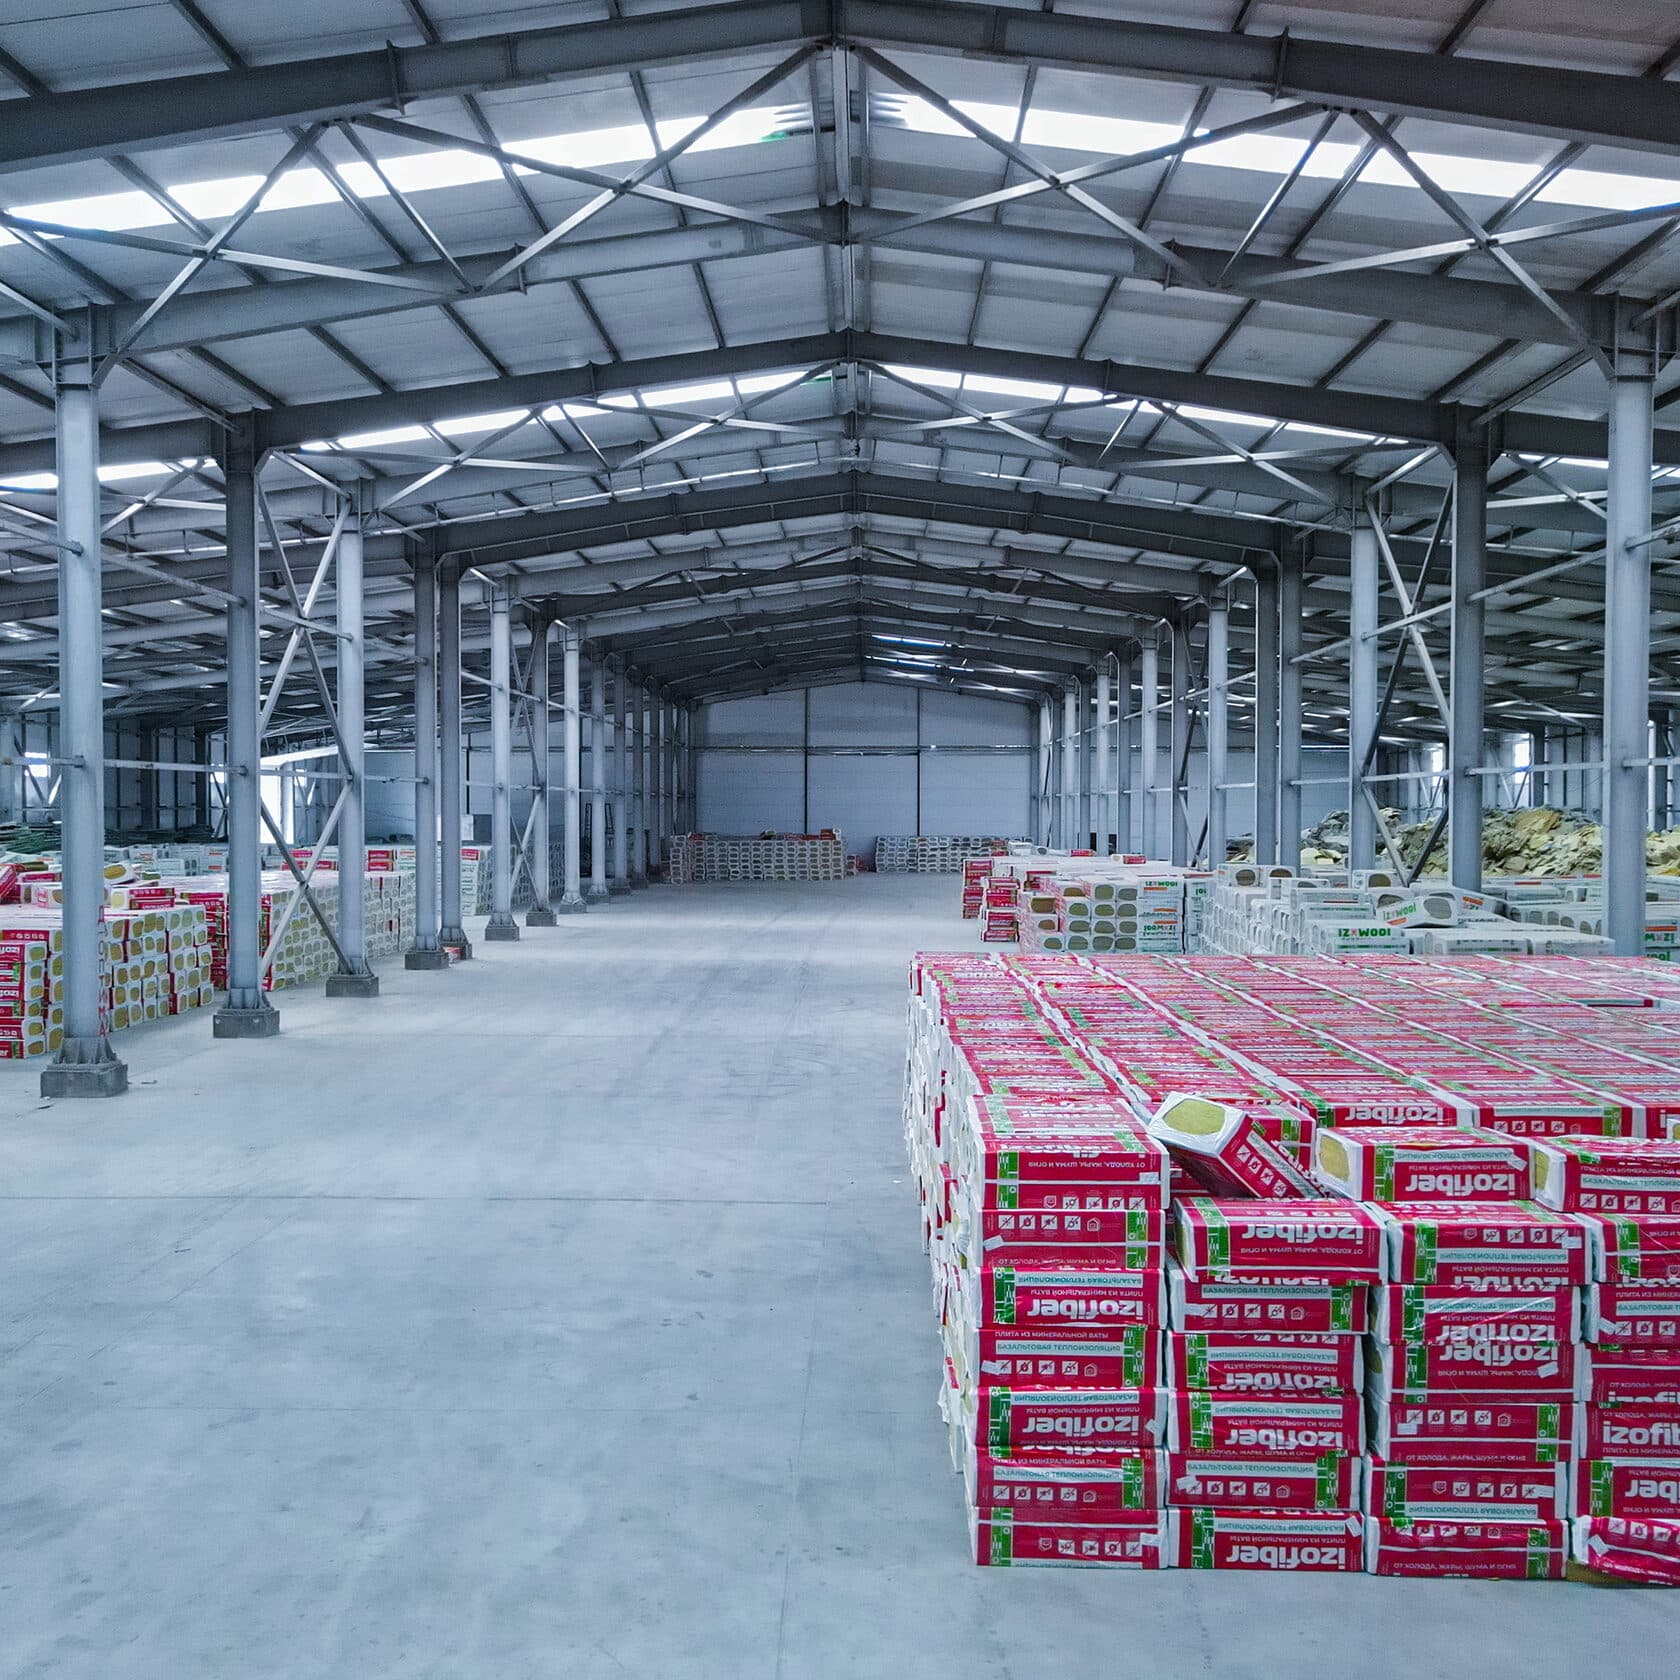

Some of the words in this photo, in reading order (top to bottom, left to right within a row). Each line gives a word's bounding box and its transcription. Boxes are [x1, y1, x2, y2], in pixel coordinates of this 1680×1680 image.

[1345, 1107, 1443, 1125] izofiber
[1405, 1174, 1515, 1197] izofiber
[1241, 1224, 1363, 1245] izofiber
[1027, 1299, 1143, 1320] izofiber
[1022, 1415, 1139, 1437] izofiber
[1224, 1429, 1343, 1450] izofiber
[1226, 1545, 1345, 1570] izofiber
